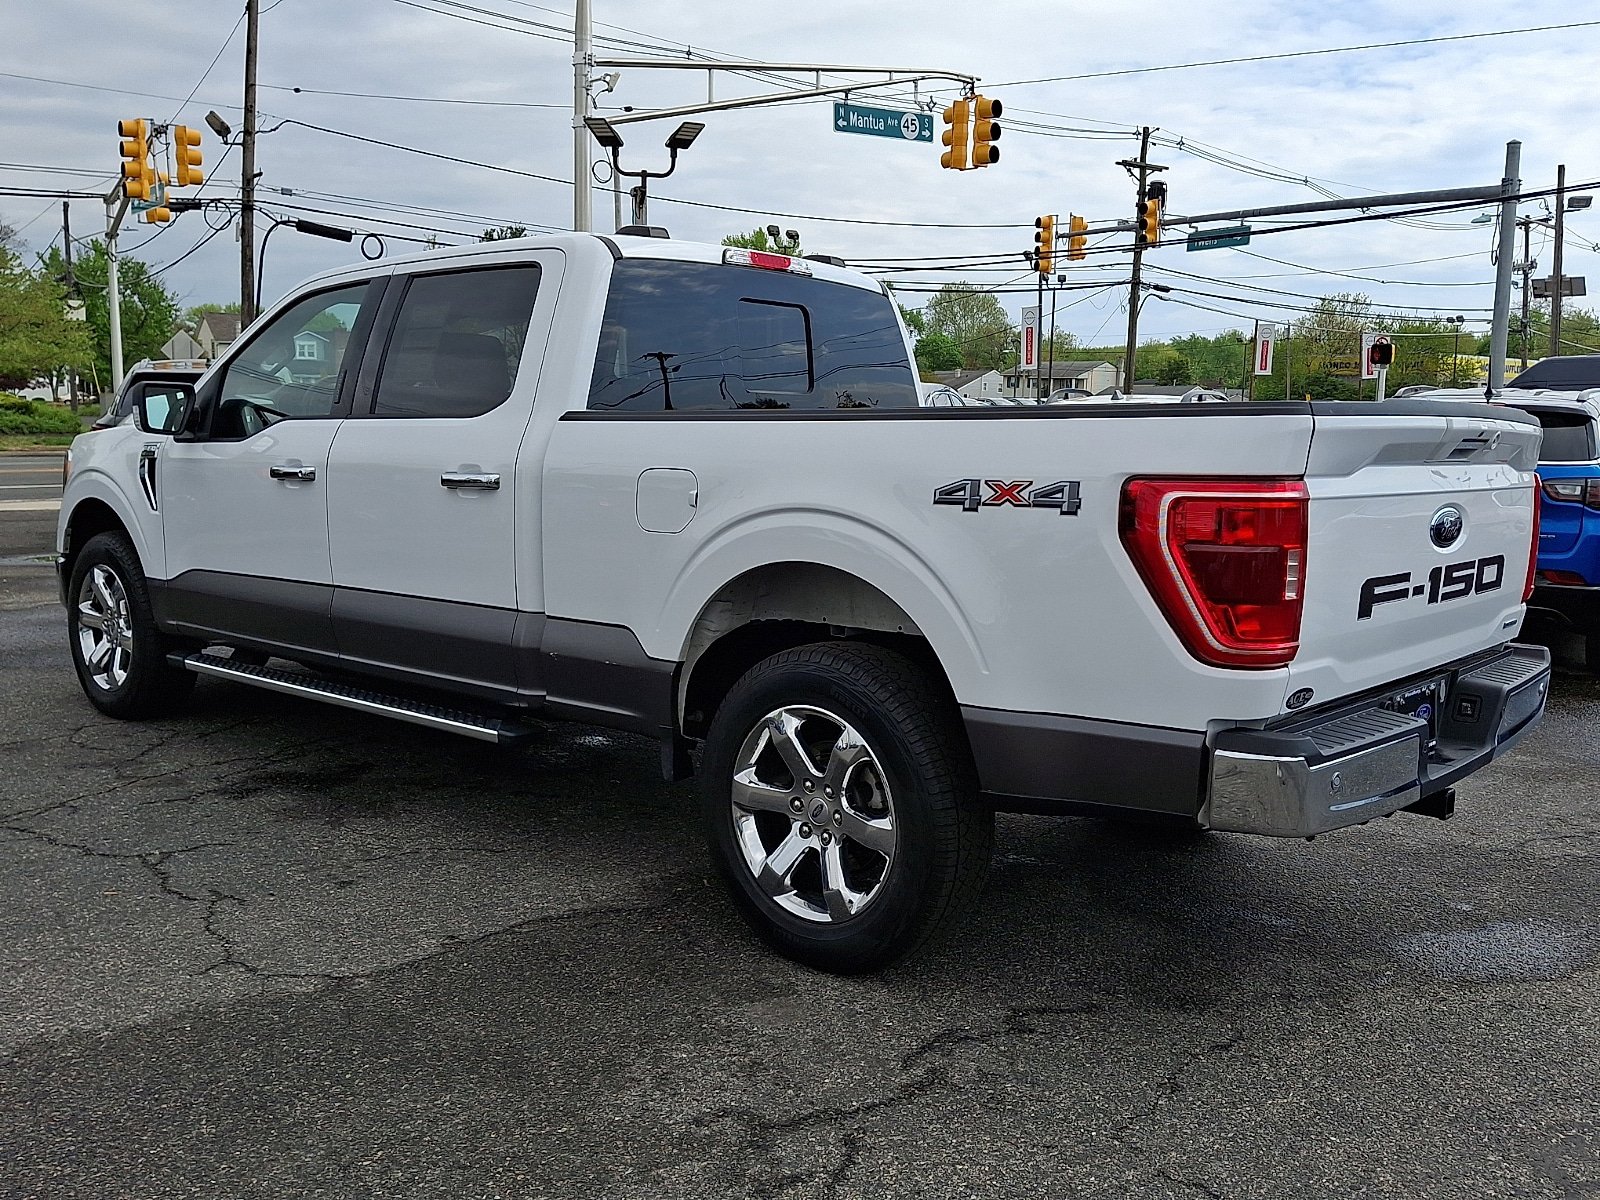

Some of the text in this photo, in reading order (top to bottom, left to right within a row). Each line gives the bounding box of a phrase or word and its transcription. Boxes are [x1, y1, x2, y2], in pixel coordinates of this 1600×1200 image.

[839, 106, 845, 117] N
[850, 110, 899, 130] Mantua Ave
[902, 118, 918, 133] 45
[924, 118, 929, 128] S
[1356, 554, 1505, 621] F-150
